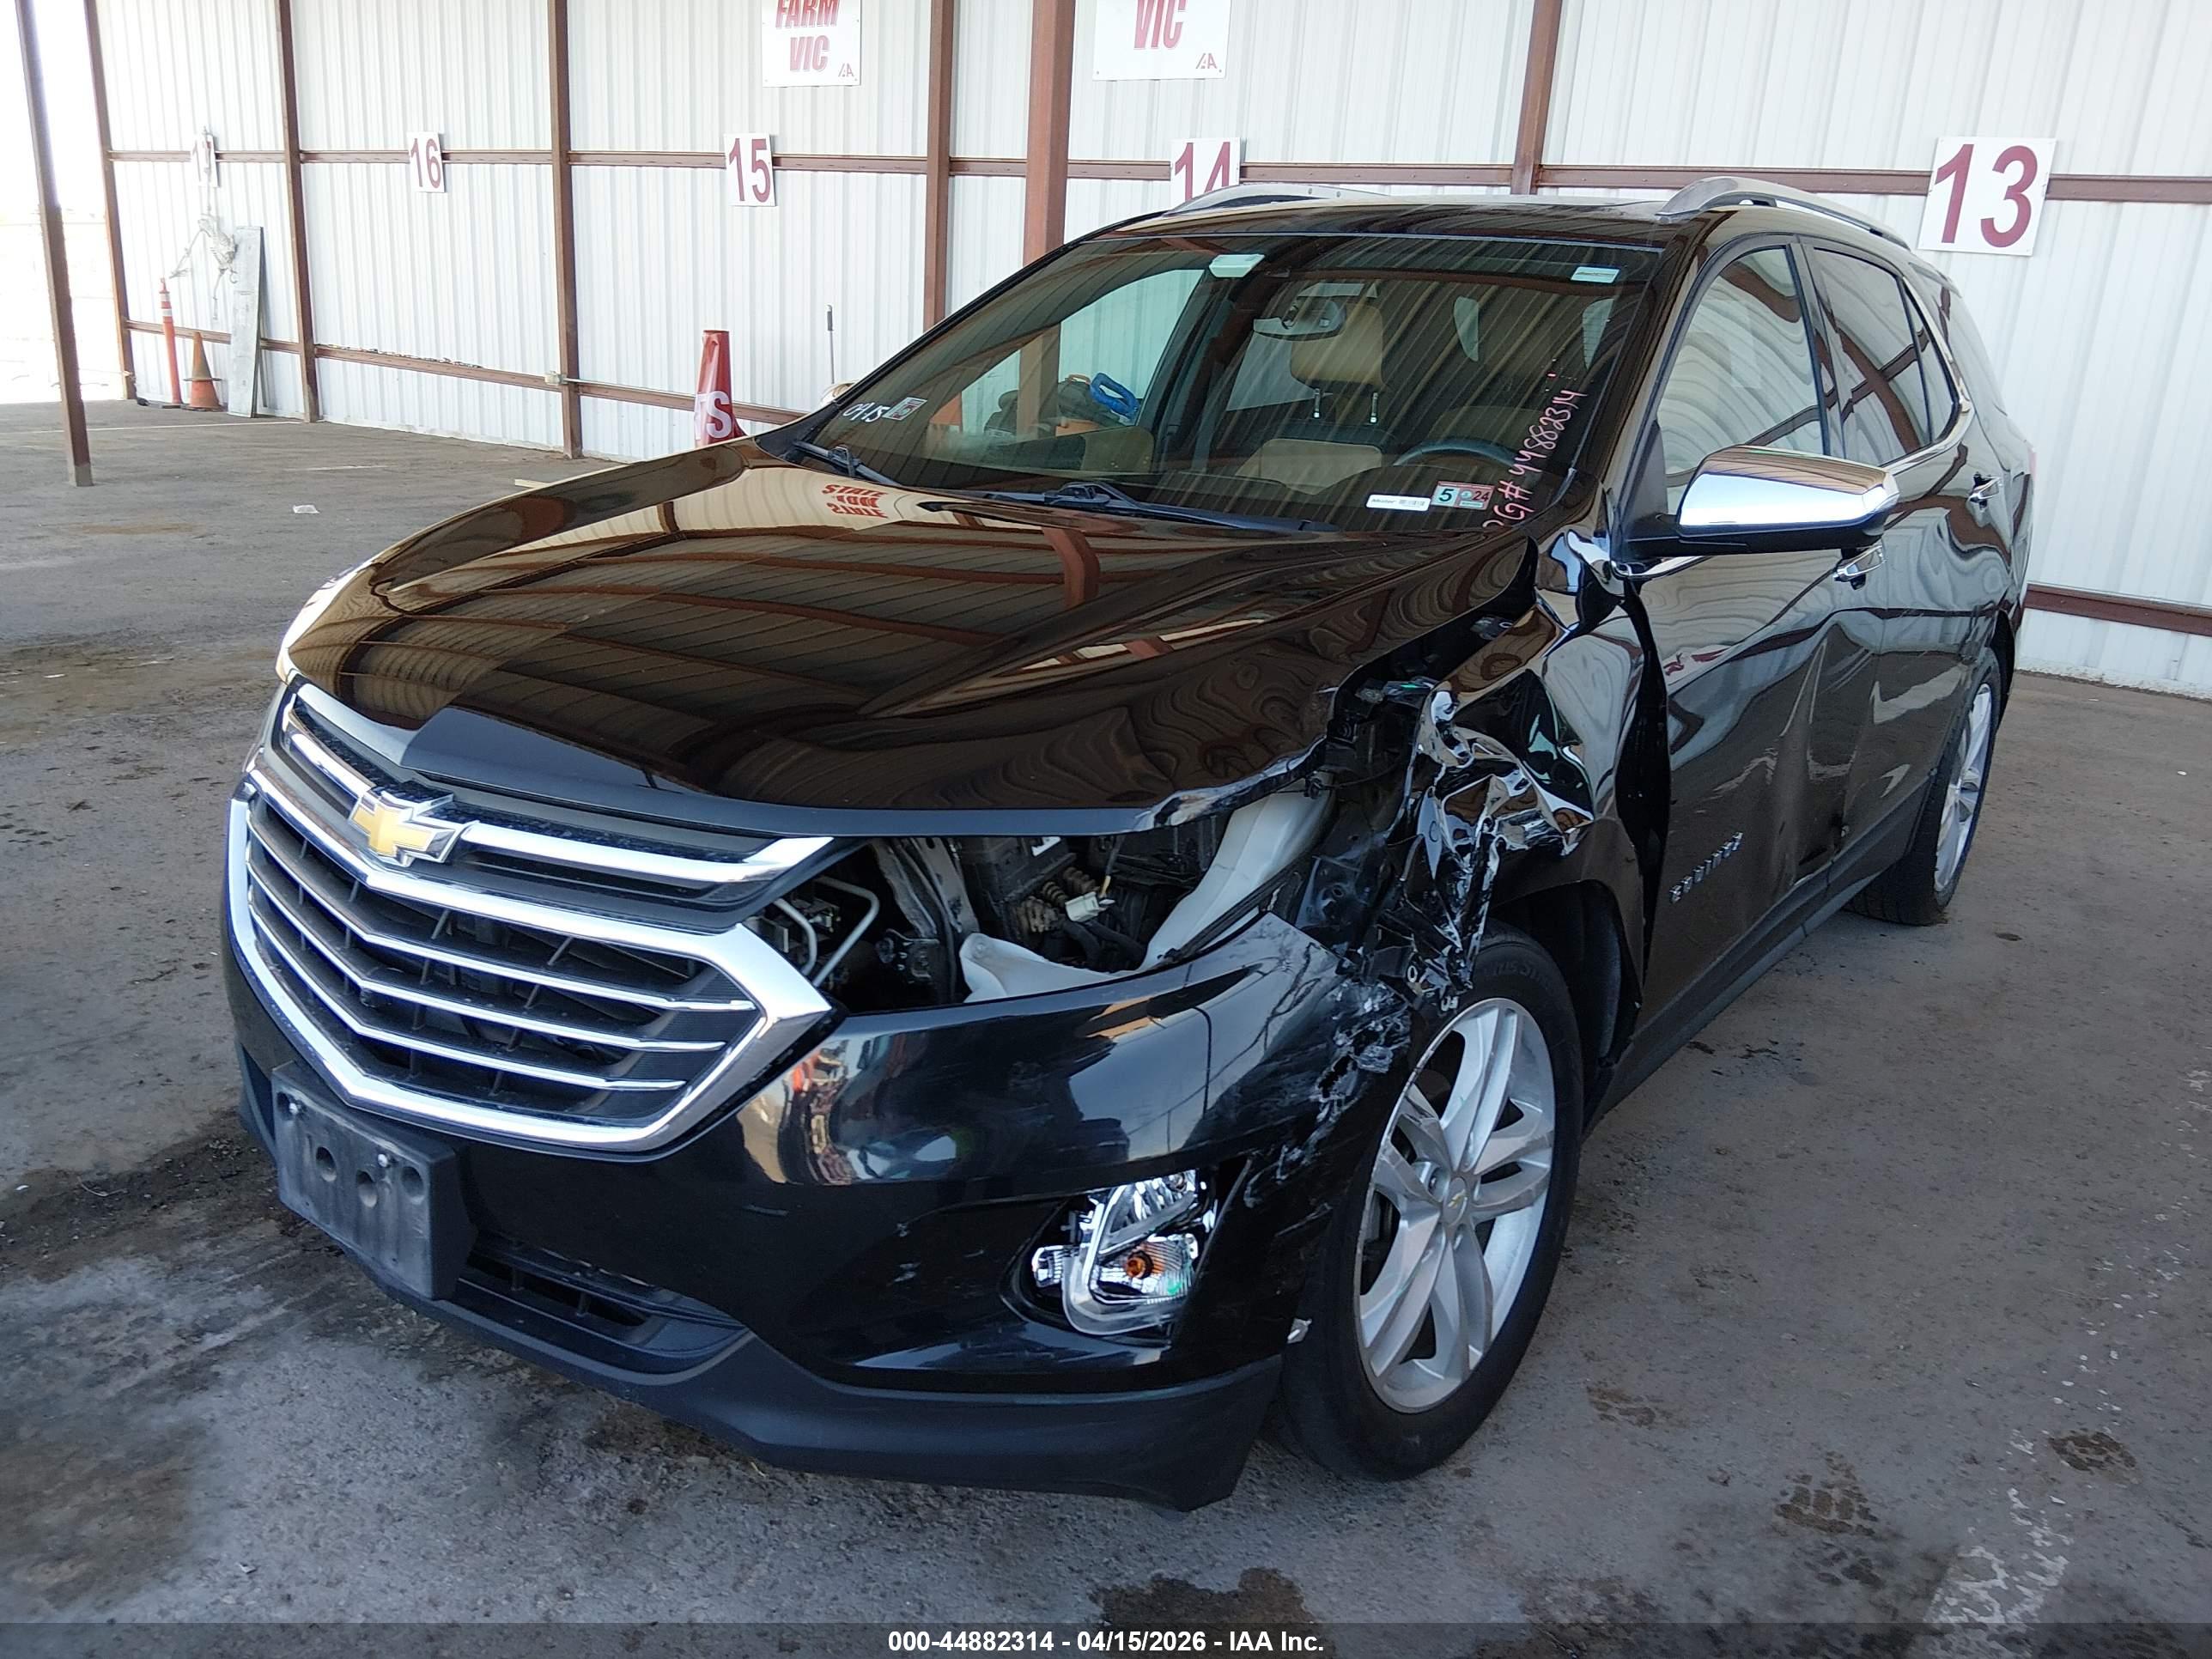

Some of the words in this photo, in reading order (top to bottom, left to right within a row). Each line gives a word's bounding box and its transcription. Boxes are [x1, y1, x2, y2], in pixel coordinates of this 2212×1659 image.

[775, 0, 841, 29] FARM
[1133, 0, 1188, 50] VIC
[790, 35, 830, 72] VIC
[410, 137, 441, 189] 16
[728, 137, 771, 203] 15
[1174, 142, 1231, 202] 14
[1934, 143, 2039, 248] 13
[1438, 488, 1455, 502] 5
[1473, 490, 1491, 502] 24
